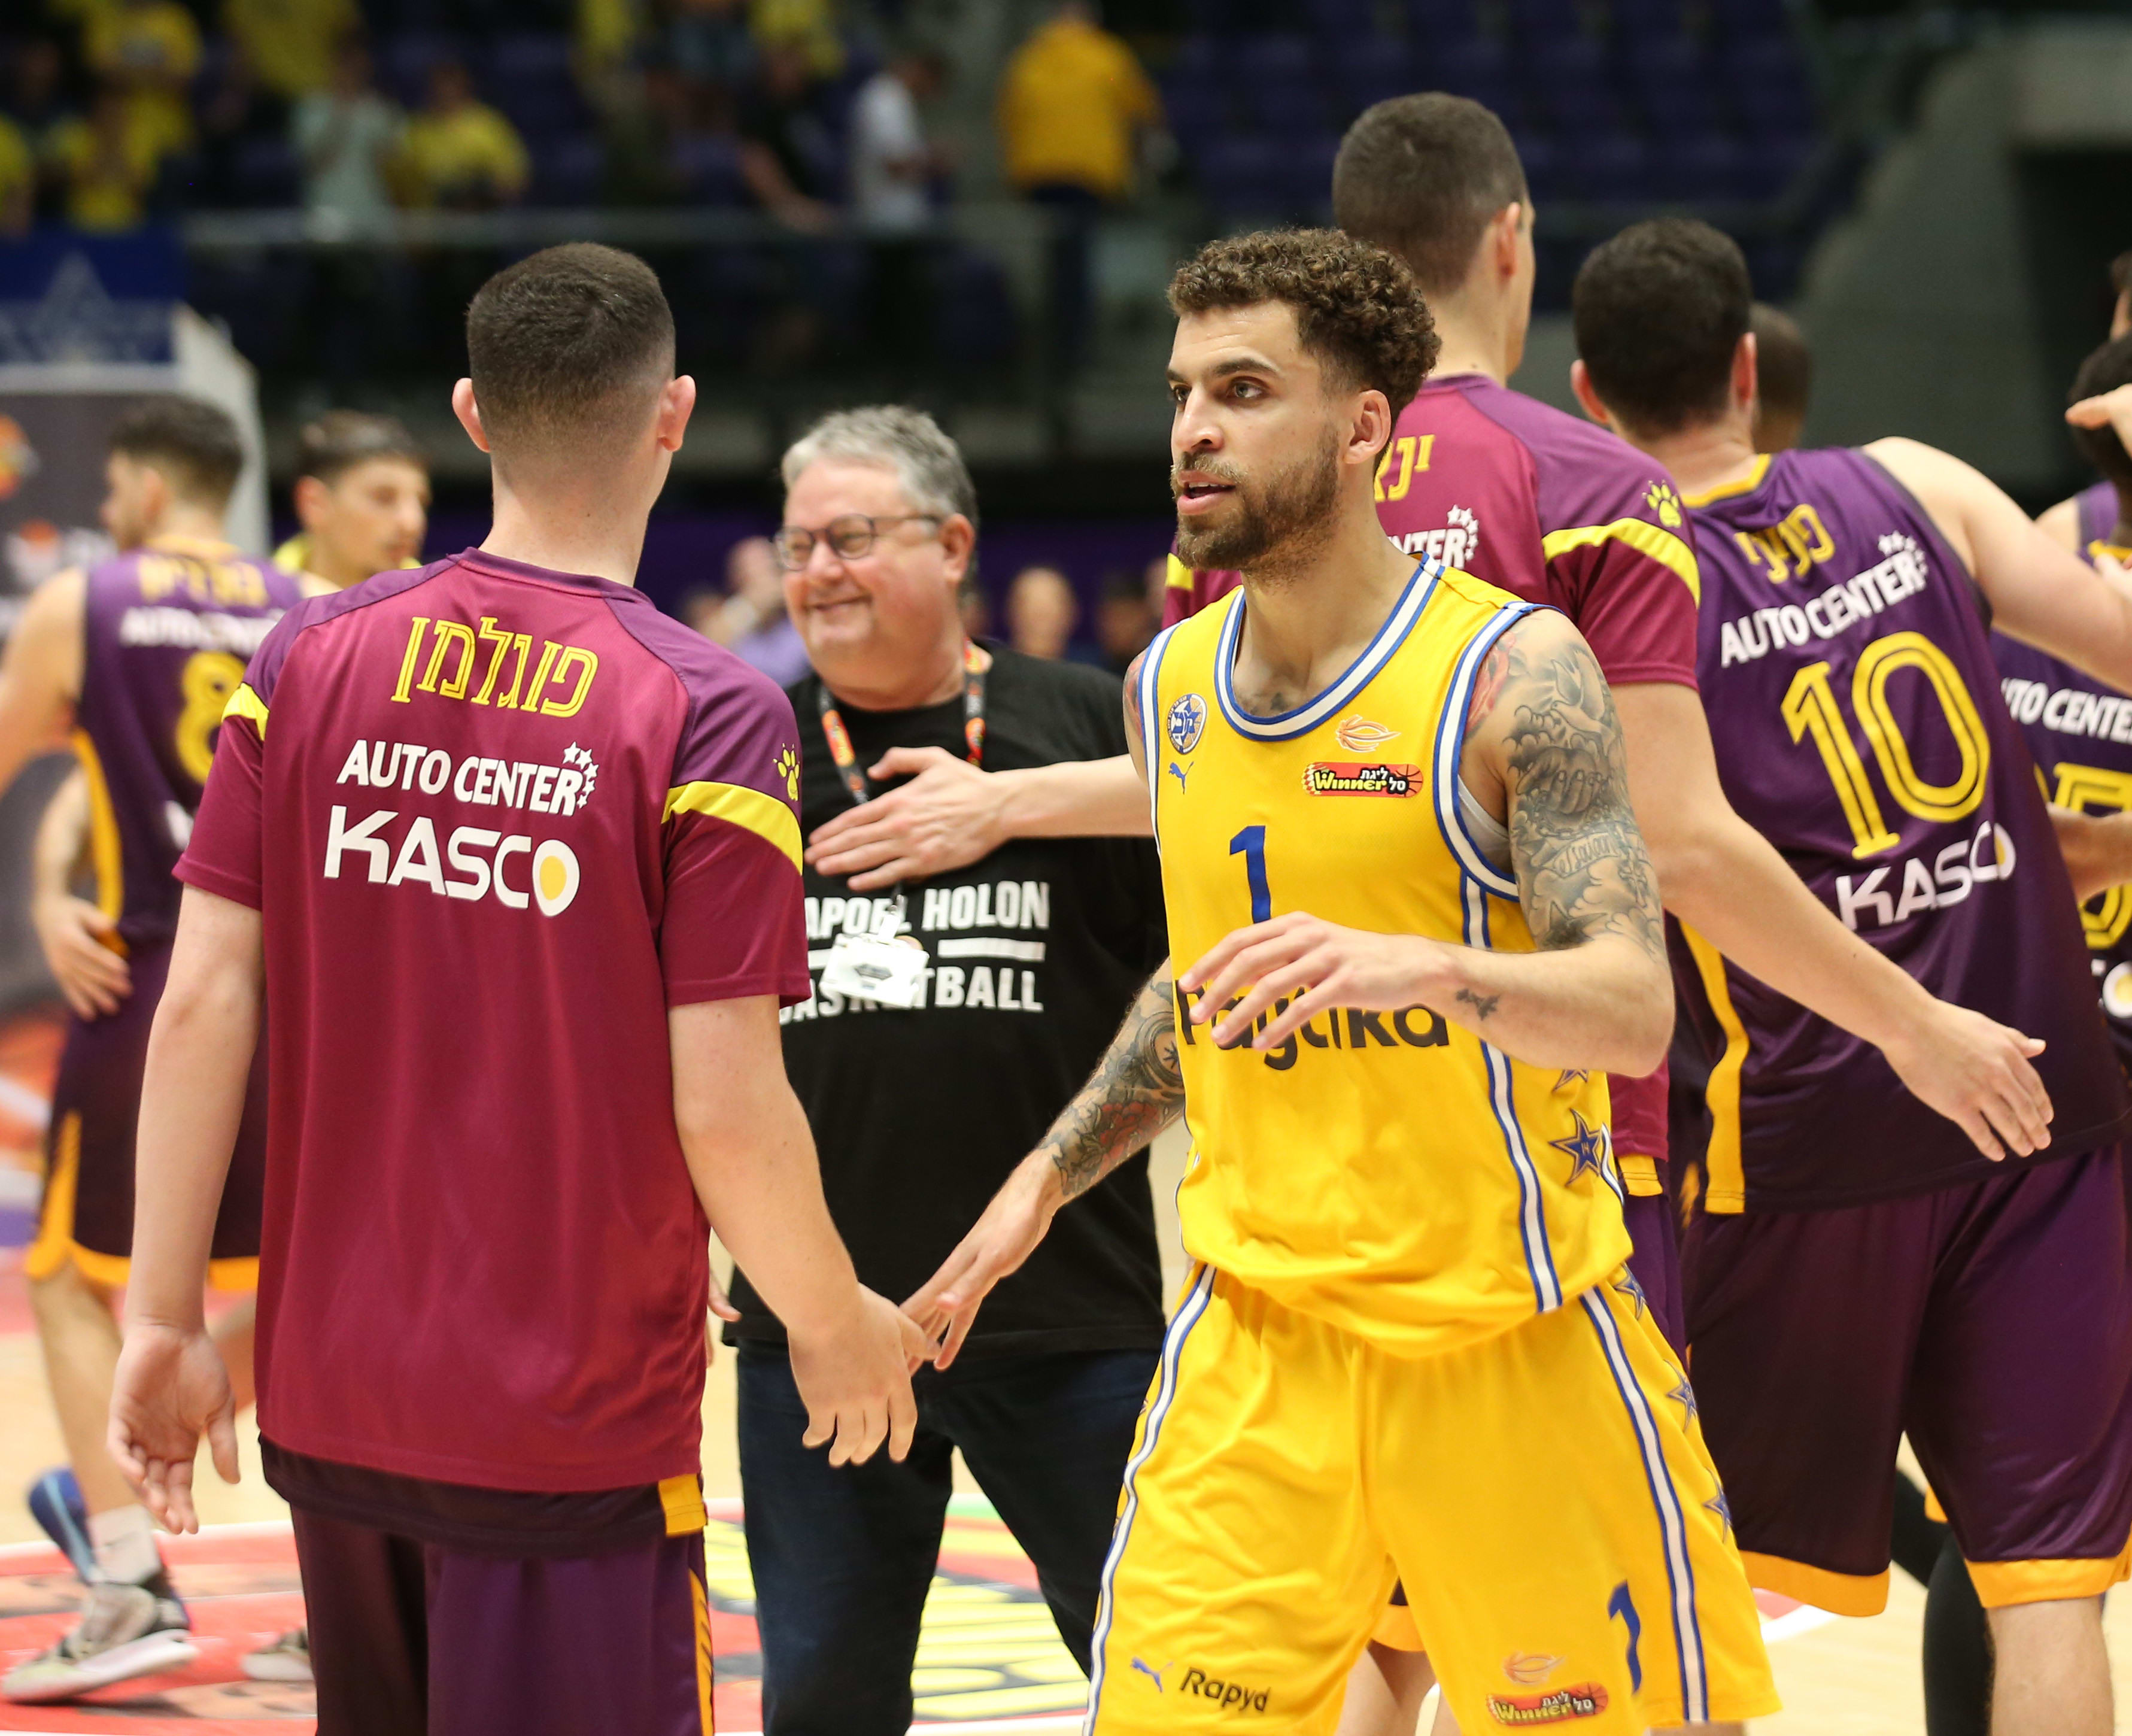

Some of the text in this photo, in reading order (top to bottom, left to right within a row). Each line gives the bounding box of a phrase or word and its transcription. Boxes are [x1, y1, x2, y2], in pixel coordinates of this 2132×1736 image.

[1721, 550, 1926, 669] AUTO CENTER
[391, 616, 599, 718] פוגלמן
[1781, 631, 1990, 860] 10
[2042, 688, 2132, 745] CENTE
[336, 739, 584, 817] AUTO CENTER
[1360, 767, 1389, 780] ליגת
[1389, 776, 1406, 791] סל
[323, 805, 581, 917] KASCO
[1229, 825, 1271, 924] 1
[921, 881, 1049, 931] HOLON
[1607, 1579, 1642, 1695] 1
[1179, 1667, 1271, 1712] Rapyd
